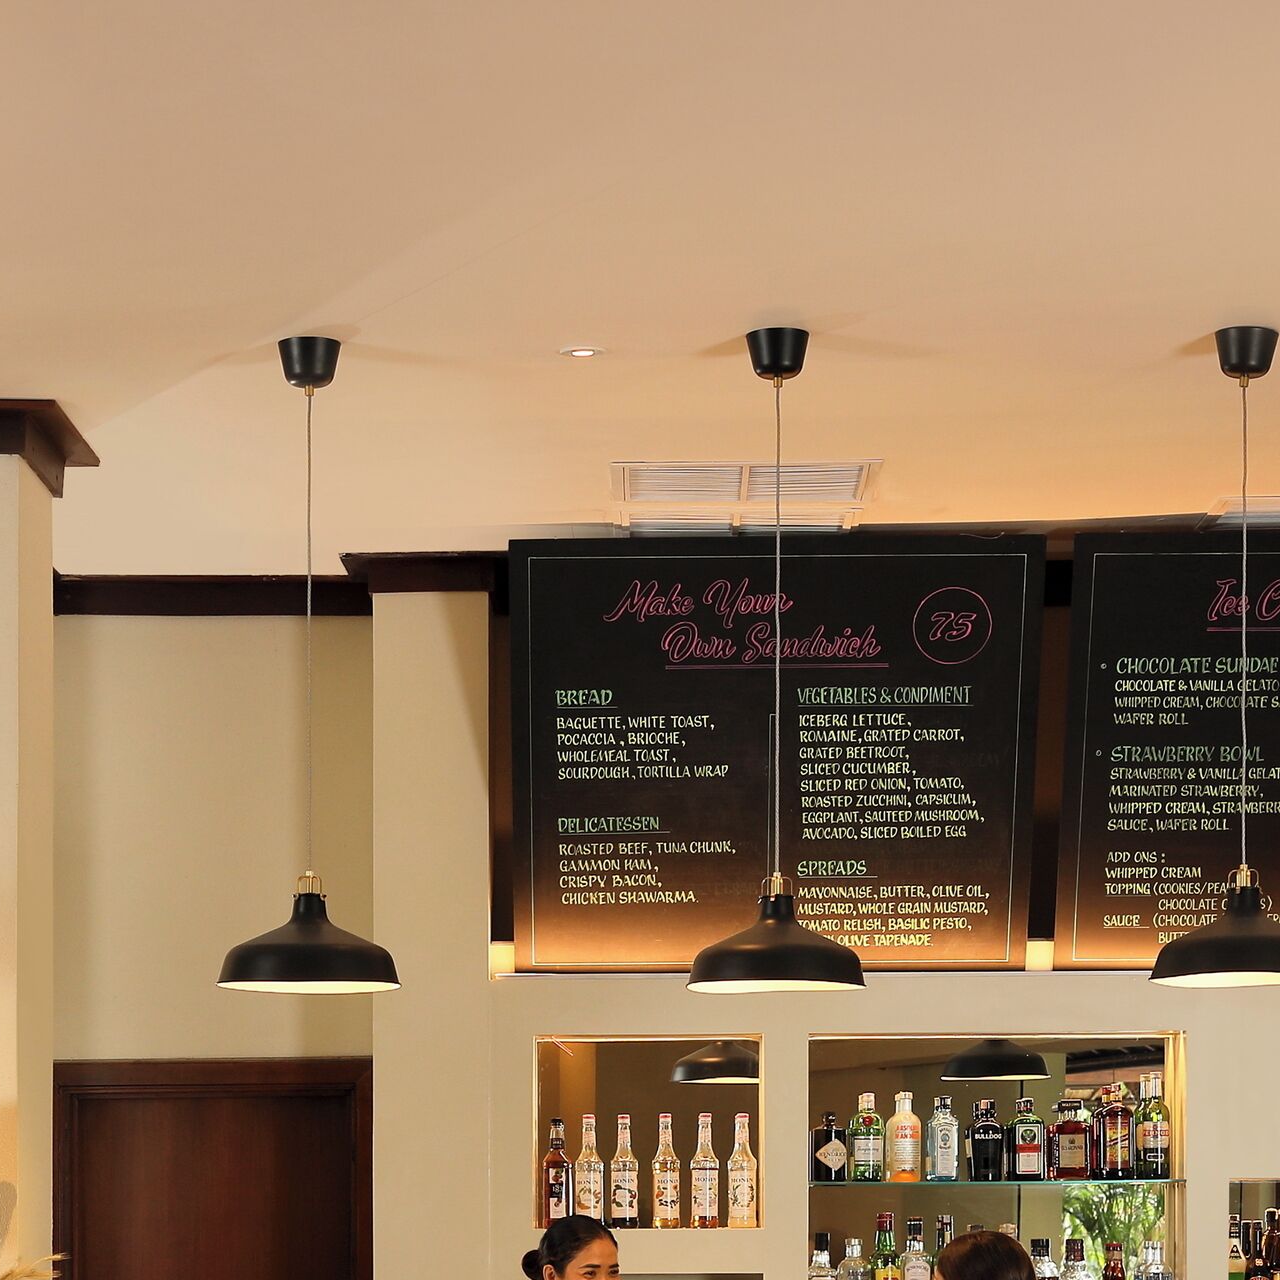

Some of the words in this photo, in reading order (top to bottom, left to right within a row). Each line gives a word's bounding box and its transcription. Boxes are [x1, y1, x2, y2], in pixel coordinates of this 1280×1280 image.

[603, 580, 694, 622] Make
[703, 577, 794, 628] Your
[1207, 579, 1249, 620] Ice
[929, 612, 976, 641] 75
[661, 622, 736, 662] Own
[742, 621, 881, 664] Sandwich
[1116, 657, 1211, 674] CHOCOLATE
[1215, 657, 1279, 674] SUNDAE
[555, 690, 612, 705] BREAD
[798, 687, 876, 705] VEGETABLES
[880, 688, 891, 704] &
[894, 685, 972, 704] CONDIMENT
[557, 716, 625, 730] BAGUETTE,
[628, 716, 665, 729] WHITE
[671, 715, 715, 730] TOAST,
[799, 714, 848, 727] ICEBERG
[853, 713, 911, 727] LETTUCE,
[800, 730, 862, 743] ROMAINE,
[864, 729, 910, 742] GRATED
[913, 728, 964, 742] CARROT,
[1110, 746, 1214, 762] STRAWBERRY
[1220, 746, 1264, 762] BOWL
[637, 766, 690, 778] TORTILLA
[694, 765, 729, 777] WRAP
[558, 816, 660, 831] DELICATESSEN
[1156, 819, 1198, 831] WAFER
[1201, 819, 1230, 831] ROLL
[802, 827, 857, 840] AVOCADO,
[860, 827, 897, 838] SLICED
[901, 826, 941, 838] BOILED
[945, 826, 966, 837] EGG
[559, 842, 614, 856] ROASTED
[619, 842, 653, 855] BEEF,
[656, 842, 688, 854] TUNA
[690, 840, 736, 854] CHUNK,
[797, 860, 867, 876] SPREADS
[1105, 867, 1157, 878] WHIPPED
[1161, 867, 1201, 878] CREAM
[559, 875, 607, 888] CRISPY
[612, 874, 662, 887] BACON,
[562, 891, 615, 905] CHICKEN
[932, 885, 963, 898] OLIVE
[966, 885, 990, 899] OIL,
